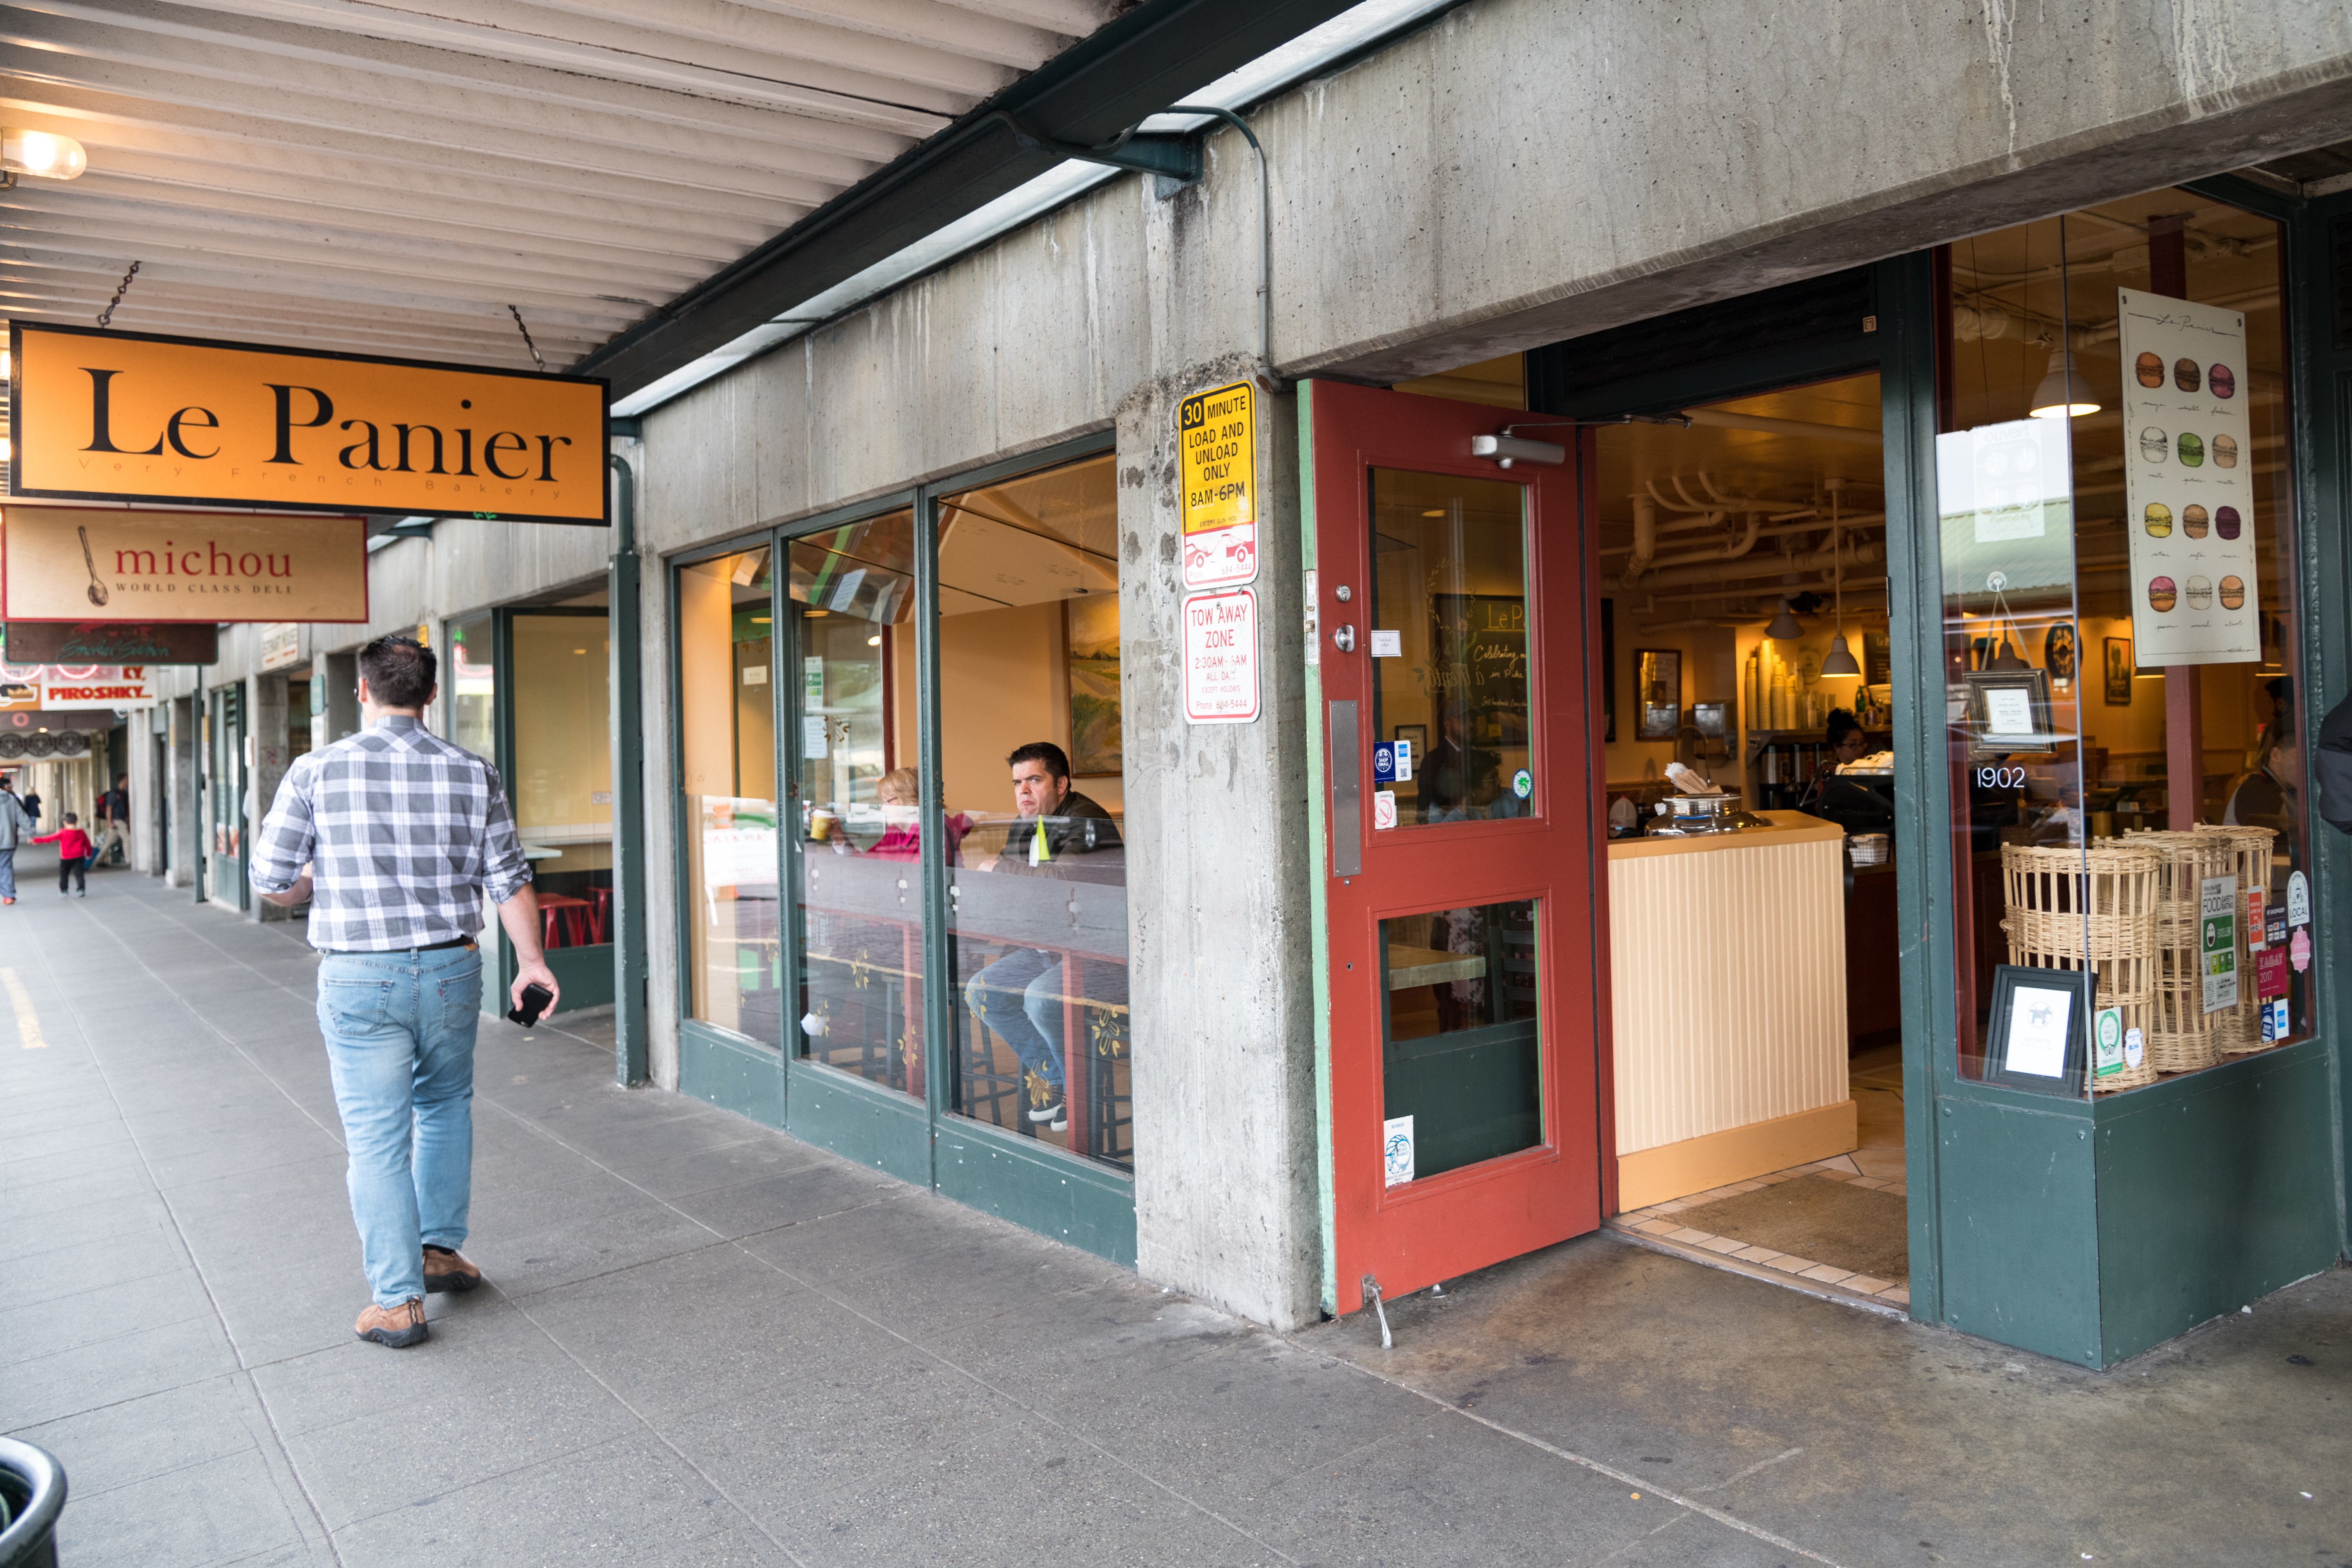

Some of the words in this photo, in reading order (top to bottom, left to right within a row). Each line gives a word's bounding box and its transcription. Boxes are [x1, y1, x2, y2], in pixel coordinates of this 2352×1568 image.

[1184, 402, 1201, 426] 30
[1207, 395, 1247, 420] MINUTE
[78, 367, 220, 459] Le
[262, 383, 572, 482] Panier
[1189, 430, 1216, 449] LOAD
[1222, 422, 1244, 443] AND
[1195, 443, 1239, 465] UNLOAD
[79, 459, 182, 477] Very
[232, 467, 382, 486] French
[426, 480, 560, 499] Bakery
[1203, 462, 1231, 482] ONLY
[1191, 481, 1245, 508] 8AM-6PM
[1217, 516, 1237, 524] SUN-HOL
[115, 540, 293, 578] michou
[1189, 571, 1204, 580] Phone
[1222, 563, 1251, 575] 684-5444
[116, 582, 176, 593] WORLD
[188, 584, 241, 593] CLASS
[253, 585, 291, 595] DELI
[1191, 608, 1213, 626] TOW
[1218, 604, 1248, 624] AWAY
[1488, 605, 1508, 629] Le
[1512, 605, 1526, 629] P
[1205, 629, 1234, 648] ZONE
[1195, 655, 1224, 669] 2:30AM
[1474, 644, 1518, 669] Celebrating
[1207, 672, 1218, 681] ALL
[1504, 668, 1524, 679] Pike
[1196, 701, 1212, 710] Phone
[1216, 699, 1247, 709] 64-5444
[1977, 767, 2025, 789] 1902
[2203, 897, 2221, 913] FOOD
[2222, 901, 2233, 910] RATING
[2290, 905, 2308, 919] LOCAL
[2259, 953, 2283, 970] ZAGAT
[2260, 970, 2273, 984] 2017
